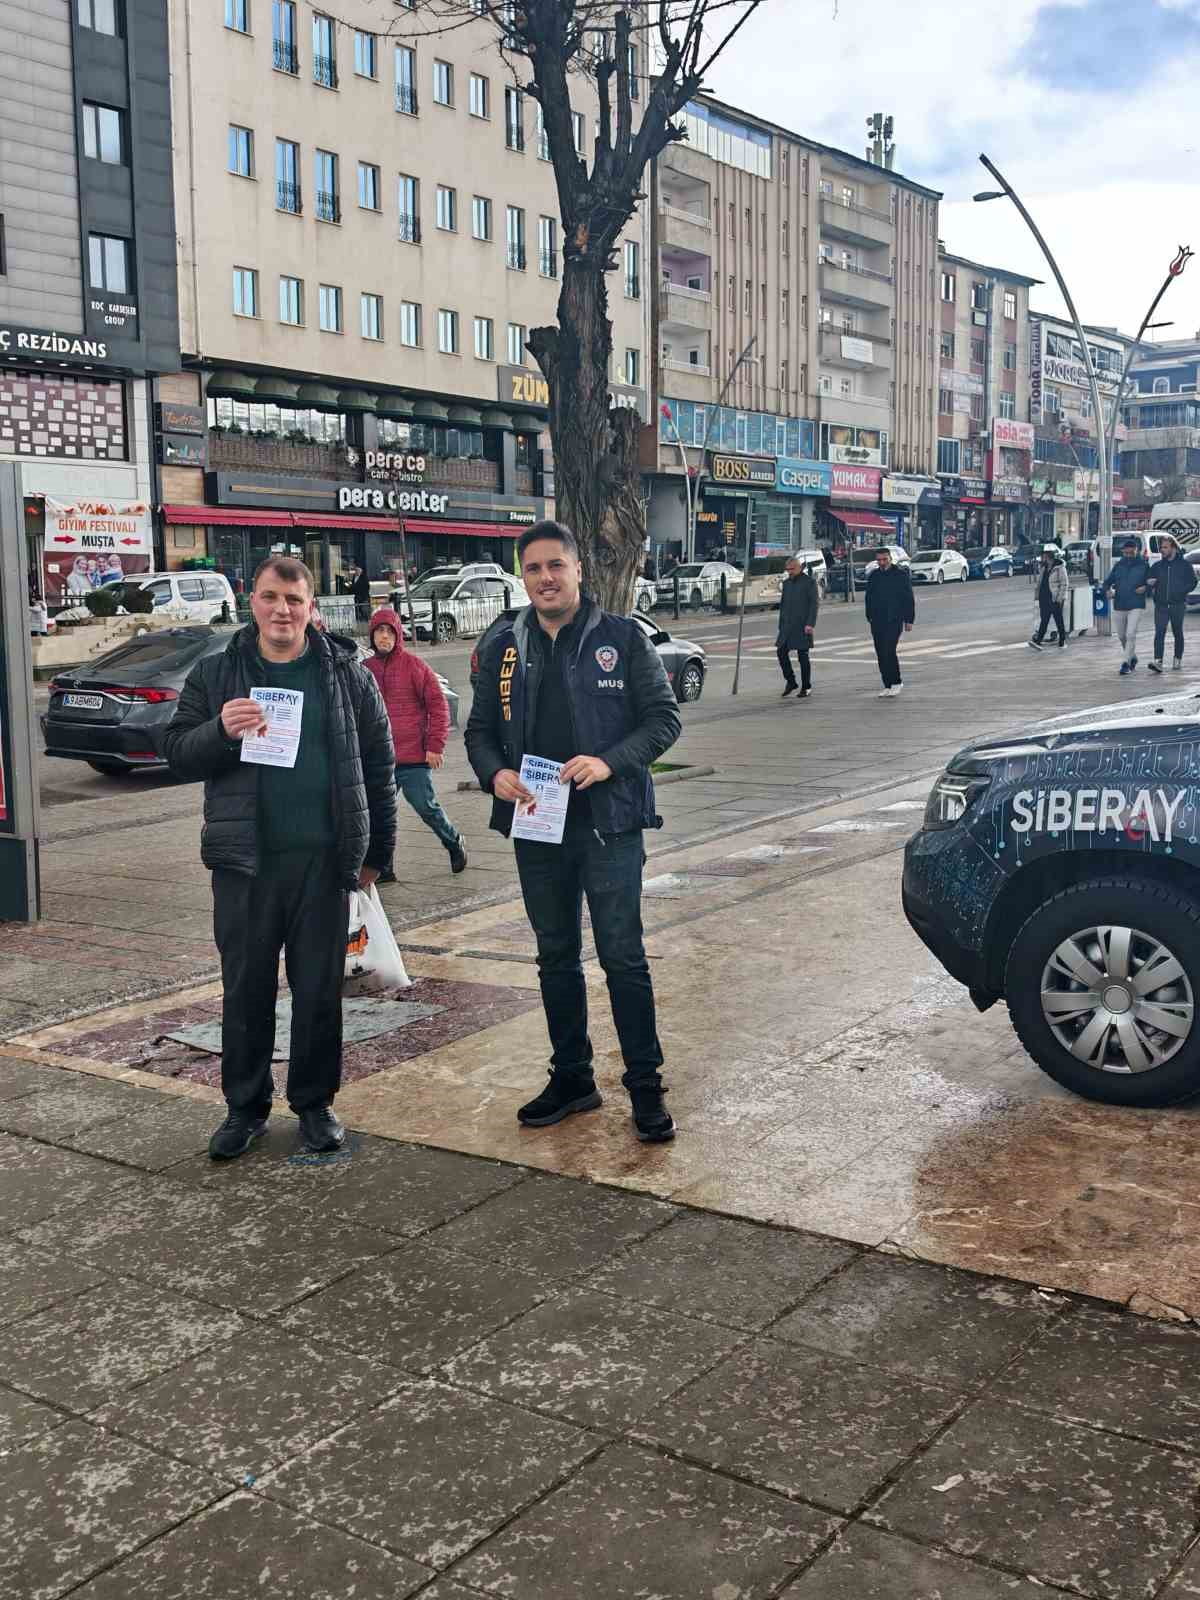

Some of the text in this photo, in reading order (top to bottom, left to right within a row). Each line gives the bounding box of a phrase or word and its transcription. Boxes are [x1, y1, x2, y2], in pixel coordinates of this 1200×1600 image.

[17, 332, 107, 358] REZİDANS
[715, 459, 750, 480] BOSS
[781, 467, 823, 491] Casper
[340, 487, 384, 509] pera
[598, 679, 624, 690] MUŞ
